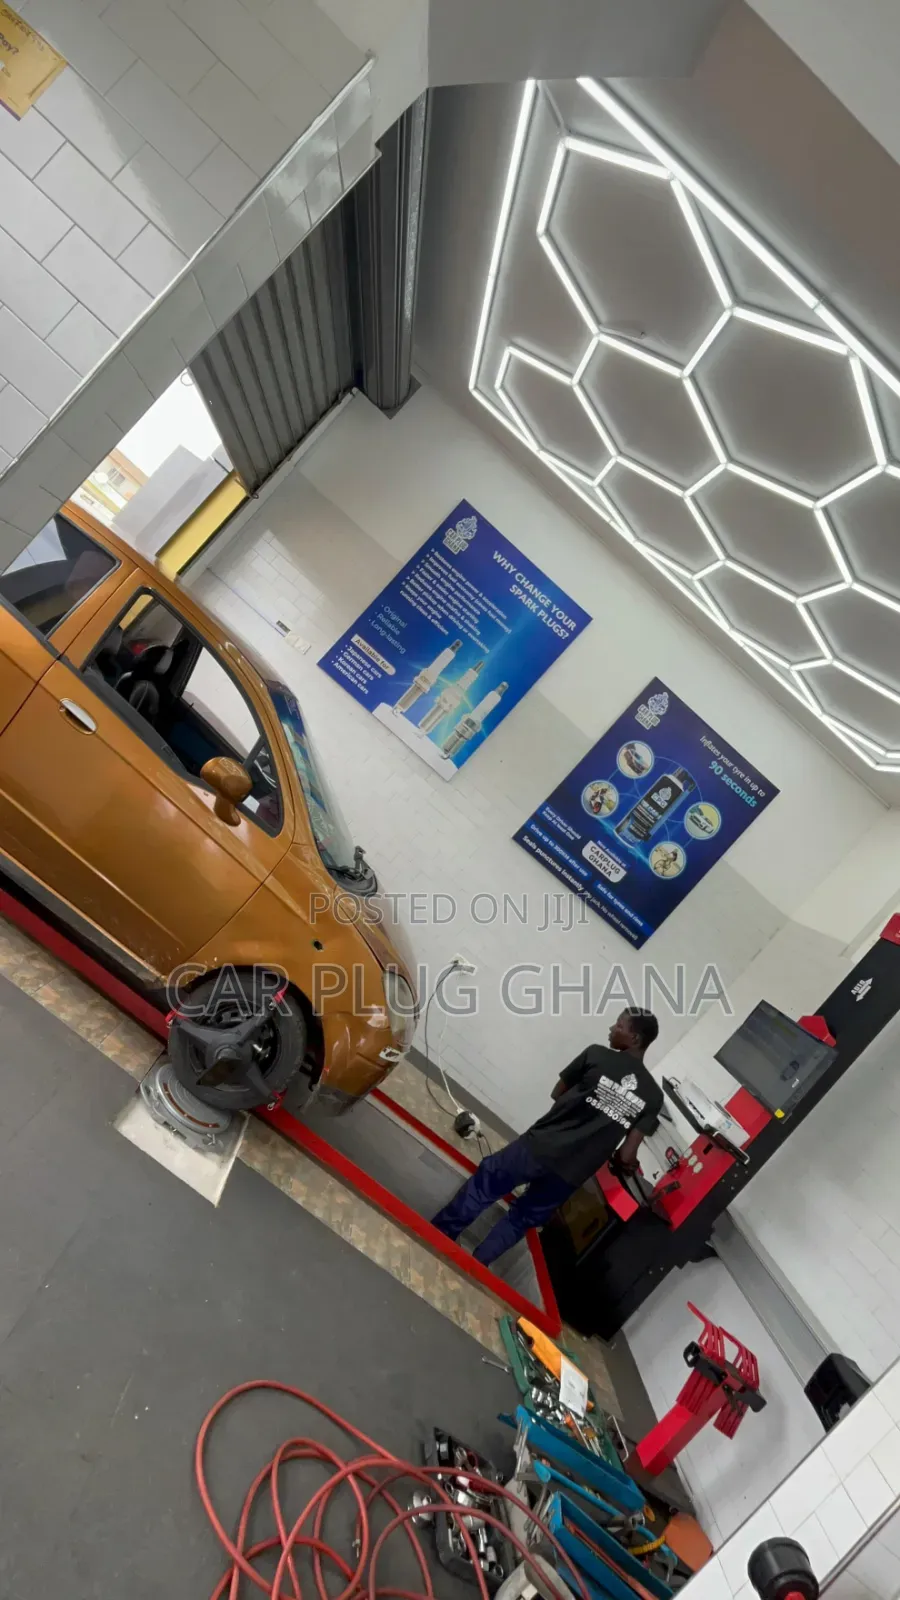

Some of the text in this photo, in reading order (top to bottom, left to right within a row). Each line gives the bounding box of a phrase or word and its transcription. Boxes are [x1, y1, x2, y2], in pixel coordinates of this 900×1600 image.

[403, 583, 442, 620] Keeps your engine
[414, 573, 433, 591] Reduces
[430, 588, 447, 605] engine
[445, 601, 461, 617] misfire
[462, 618, 481, 636] shaking
[418, 567, 433, 581] Faster
[435, 582, 449, 596] easier
[446, 594, 463, 610] engine
[461, 607, 479, 624] starting
[423, 562, 481, 616] Smooth engine performance
[427, 556, 448, 576] Improves
[446, 573, 457, 583] fuel
[454, 581, 475, 601] economy
[486, 610, 496, 620] fuel
[433, 551, 452, 569] Restores
[450, 567, 466, 583] engine
[464, 580, 479, 595] power
[481, 595, 507, 620] acceleration
[490, 550, 577, 631] WHY CHANGE YOUR
[376, 612, 401, 636] Reliable
[381, 605, 407, 629] Original
[398, 589, 417, 607] running
[415, 604, 428, 616] clean
[430, 617, 449, 635] efficient
[409, 578, 424, 592] Better
[421, 590, 437, 606] pickup
[436, 603, 449, 616] when
[446, 613, 463, 630] driving
[466, 631, 490, 654] overtaking
[508, 583, 569, 640] SPARK PLUGS?
[354, 637, 390, 671] Available for
[369, 619, 407, 655] Long-lasting
[332, 661, 368, 694] American cars
[337, 656, 367, 684] Korean cars
[342, 651, 374, 681] German cars
[346, 645, 382, 678] Japanese cars
[698, 735, 766, 797] Inflates your tyre in up to
[707, 759, 759, 808] 90 seconds
[521, 834, 537, 850] Seals
[534, 846, 563, 873] punctures
[559, 869, 584, 892] instantly
[529, 823, 543, 836] Drive
[540, 835, 549, 843] up
[568, 857, 580, 869] after
[578, 867, 588, 877] use
[587, 854, 612, 877] GHANA
[589, 845, 621, 875] CARPLUG
[596, 883, 608, 894] Safe
[605, 891, 614, 900] for
[611, 898, 625, 911] tyres
[623, 908, 633, 917] and
[631, 915, 643, 927] rims
